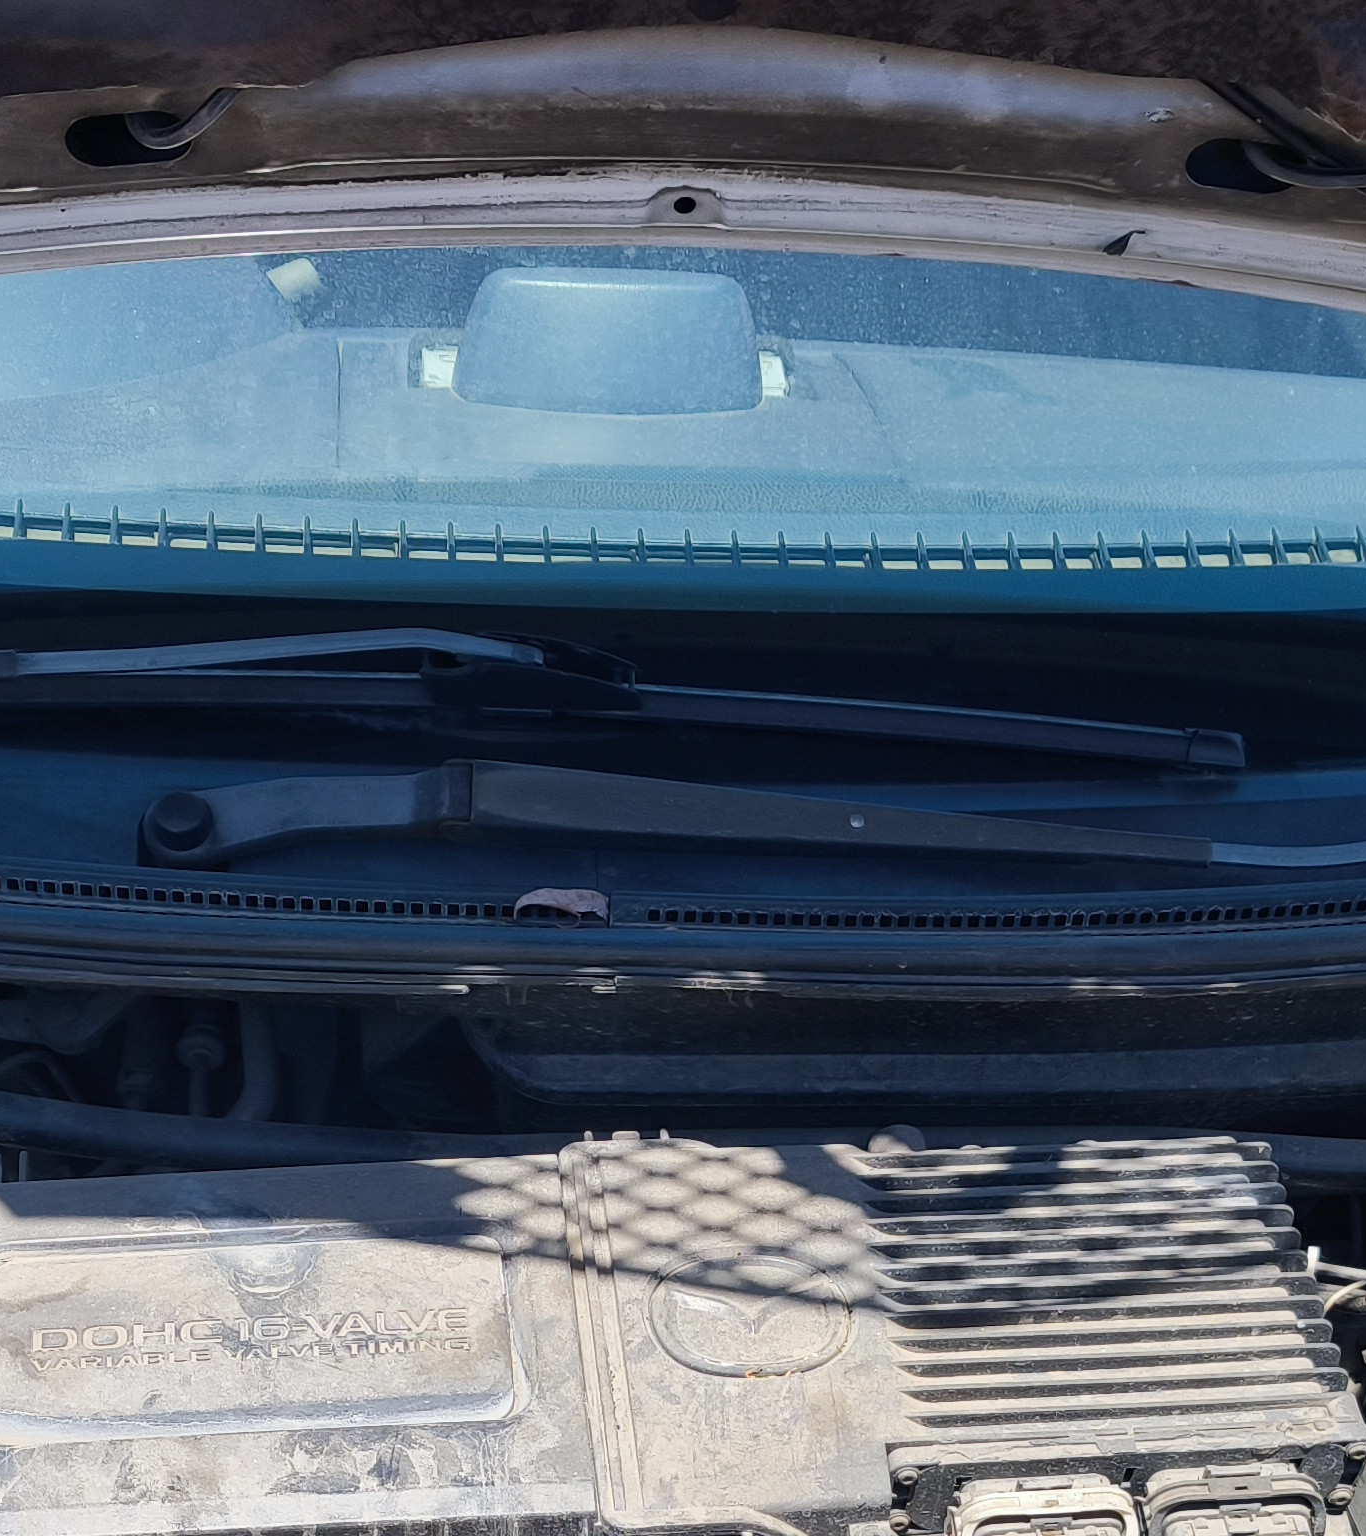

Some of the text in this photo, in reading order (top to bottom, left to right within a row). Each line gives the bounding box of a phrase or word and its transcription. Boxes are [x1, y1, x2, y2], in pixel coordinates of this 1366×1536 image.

[32, 1306, 469, 1353] DOHC 16-VALVE
[33, 1336, 471, 1372] VARIABLE VALVE TIMING
